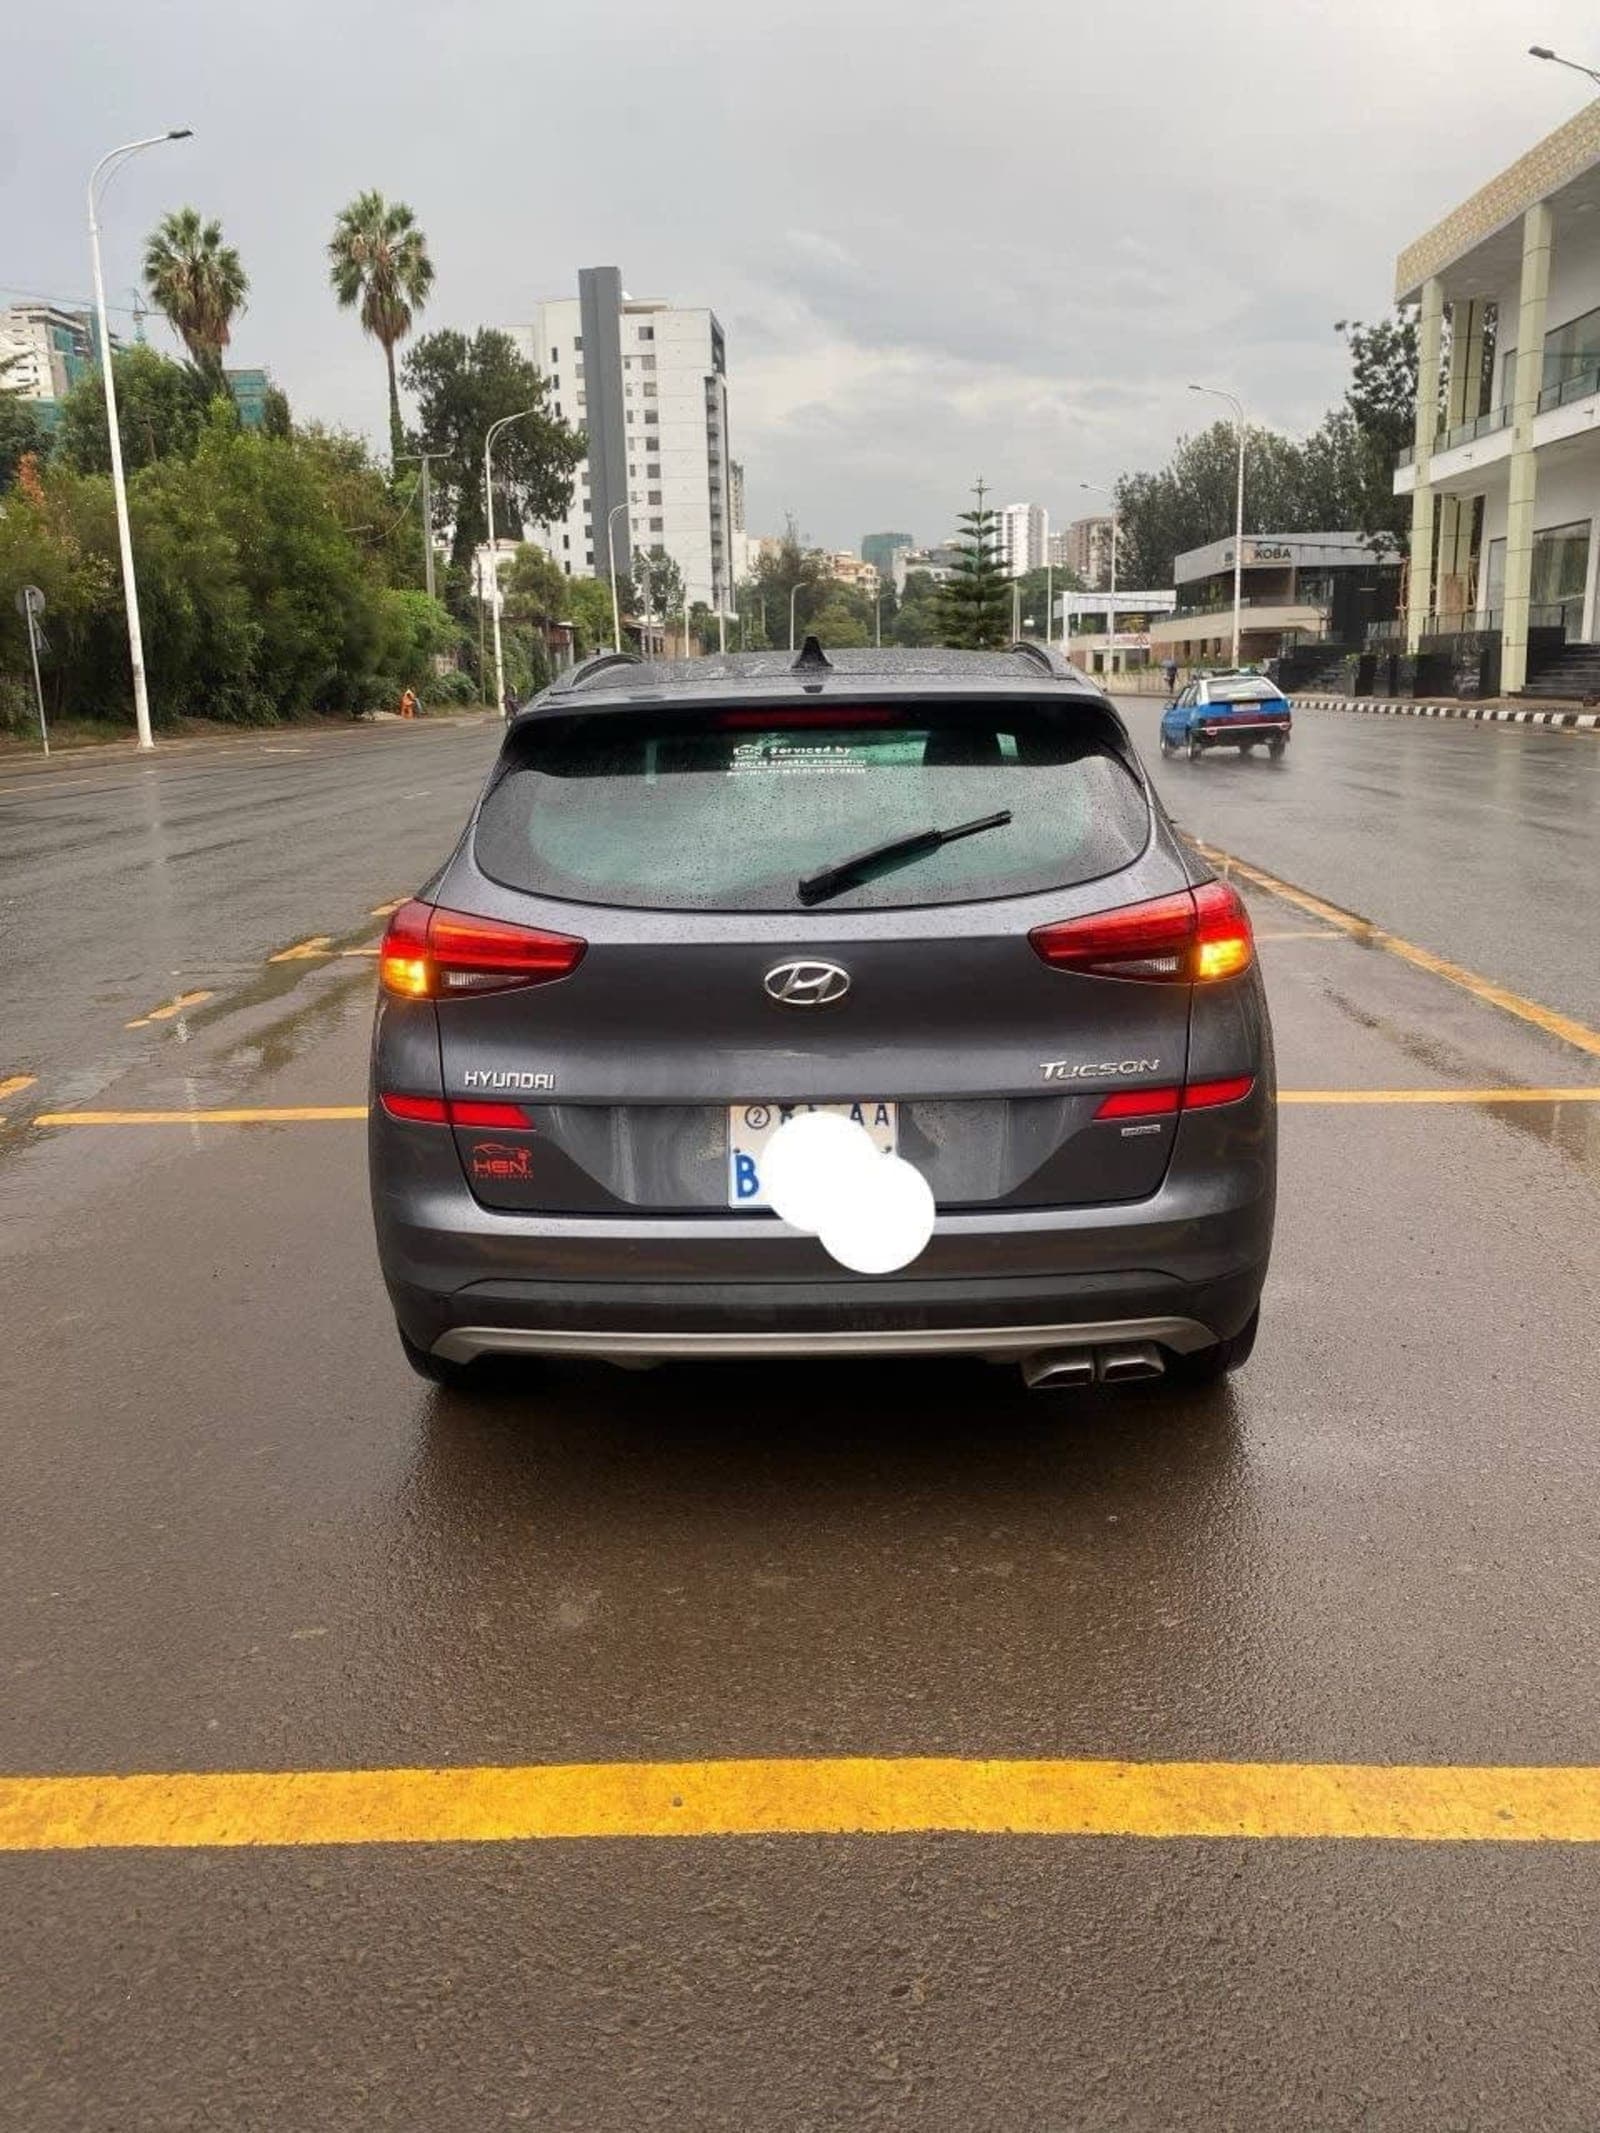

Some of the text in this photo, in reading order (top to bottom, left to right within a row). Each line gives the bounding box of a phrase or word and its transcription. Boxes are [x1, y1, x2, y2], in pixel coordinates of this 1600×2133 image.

[770, 746, 831, 755] Serviced
[835, 746, 851, 758] by
[464, 1070, 554, 1089] HYUNDAI
